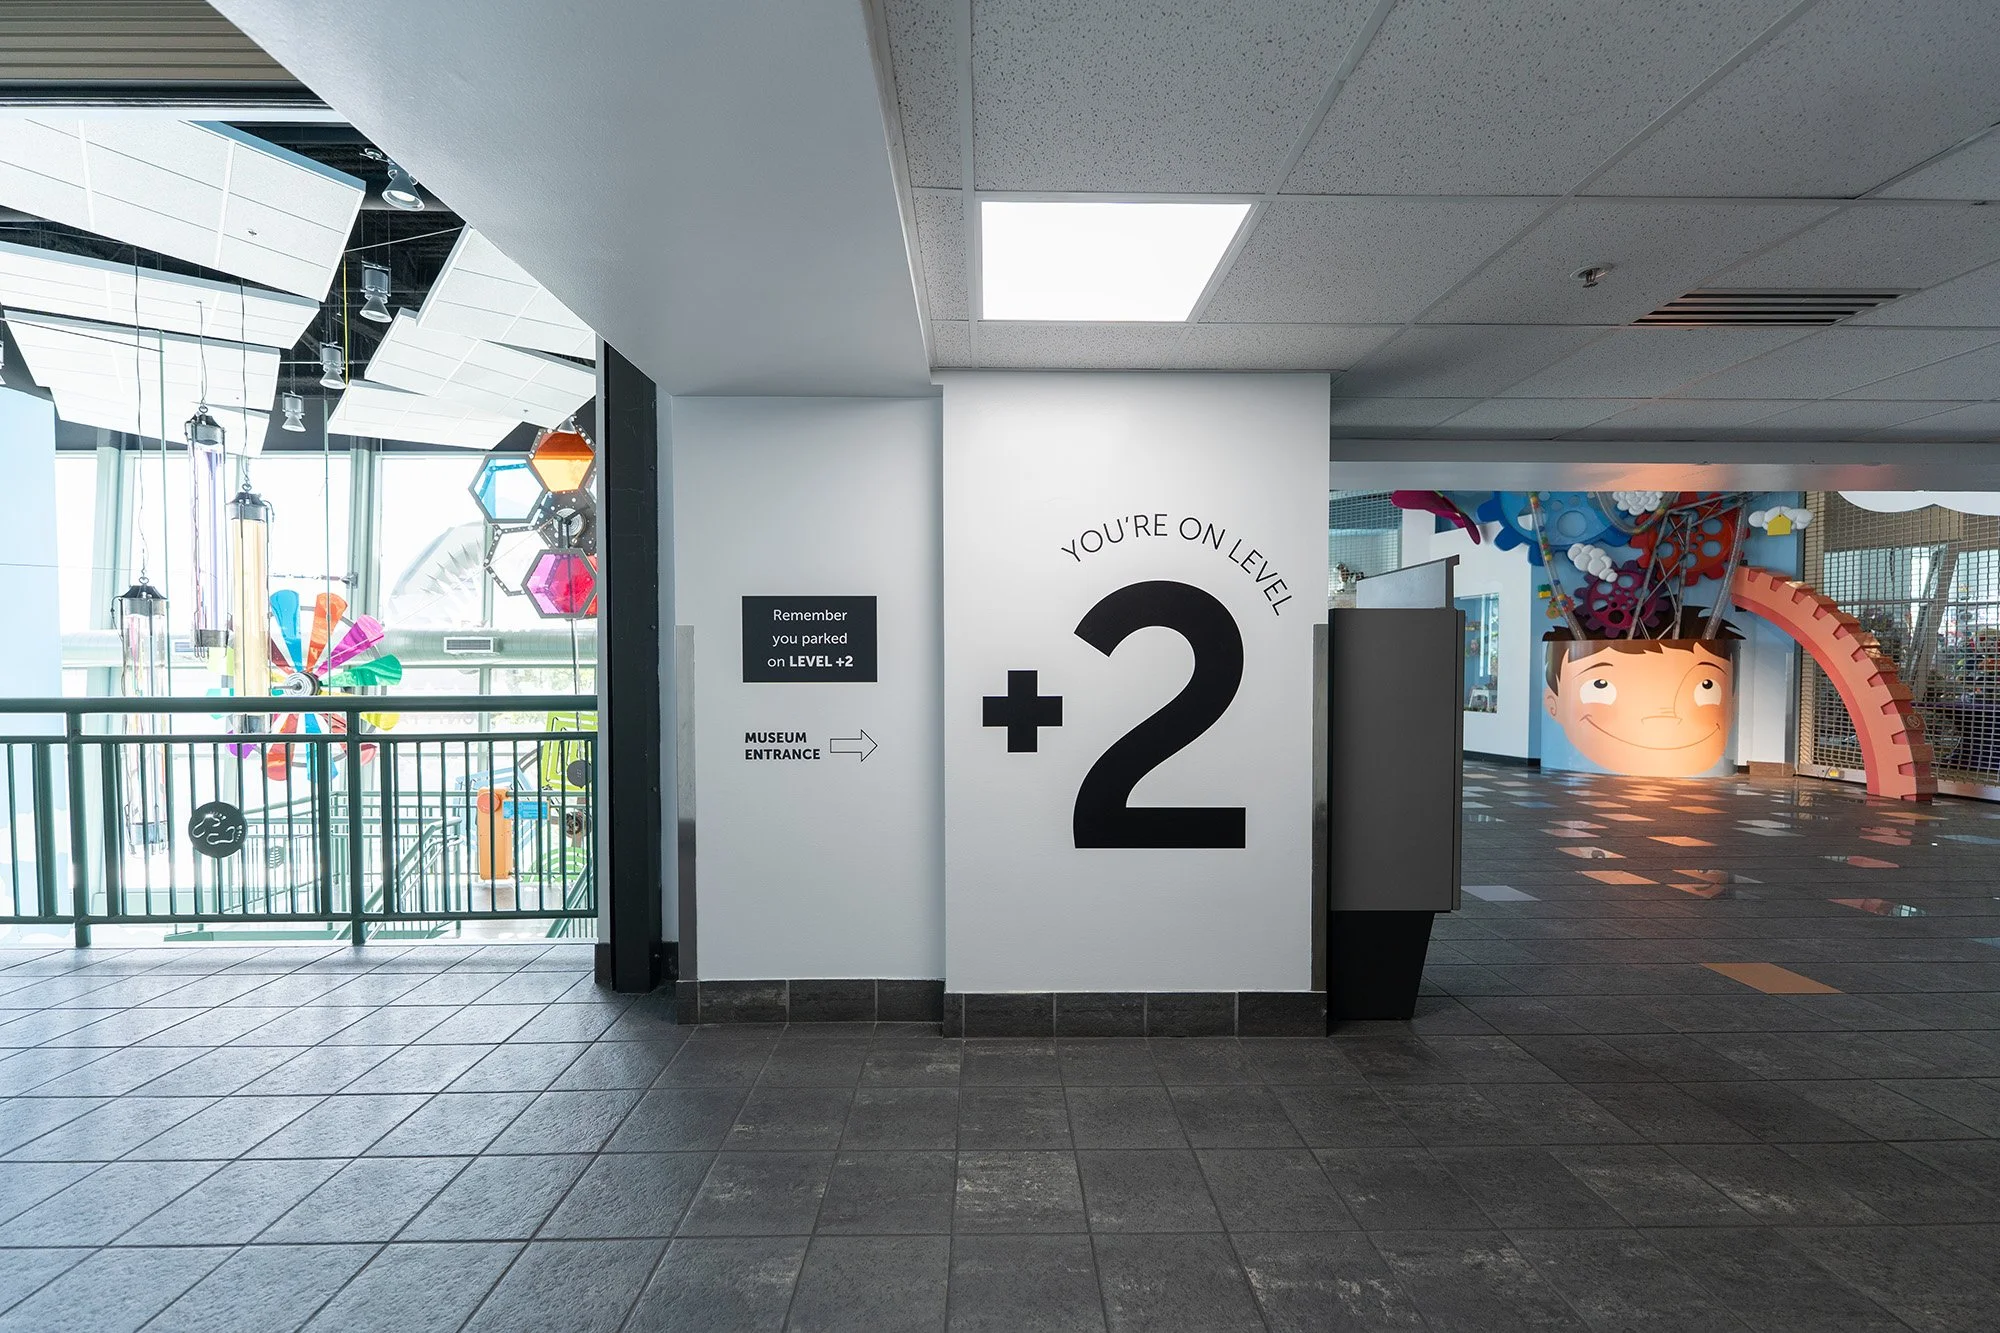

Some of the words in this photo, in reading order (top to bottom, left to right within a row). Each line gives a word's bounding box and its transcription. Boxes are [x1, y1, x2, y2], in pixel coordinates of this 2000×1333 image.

[1061, 513, 1168, 562] YOU'RE
[1179, 517, 1226, 550] ON
[1228, 538, 1293, 616] LEVEL
[773, 609, 848, 621] Remember
[772, 635, 798, 648] you
[801, 632, 848, 648] parked
[767, 658, 785, 668] on
[789, 655, 833, 667] LEVEL
[835, 655, 854, 667] +2
[744, 731, 807, 744] MUSEUM
[744, 749, 820, 761] ENTRANCE
